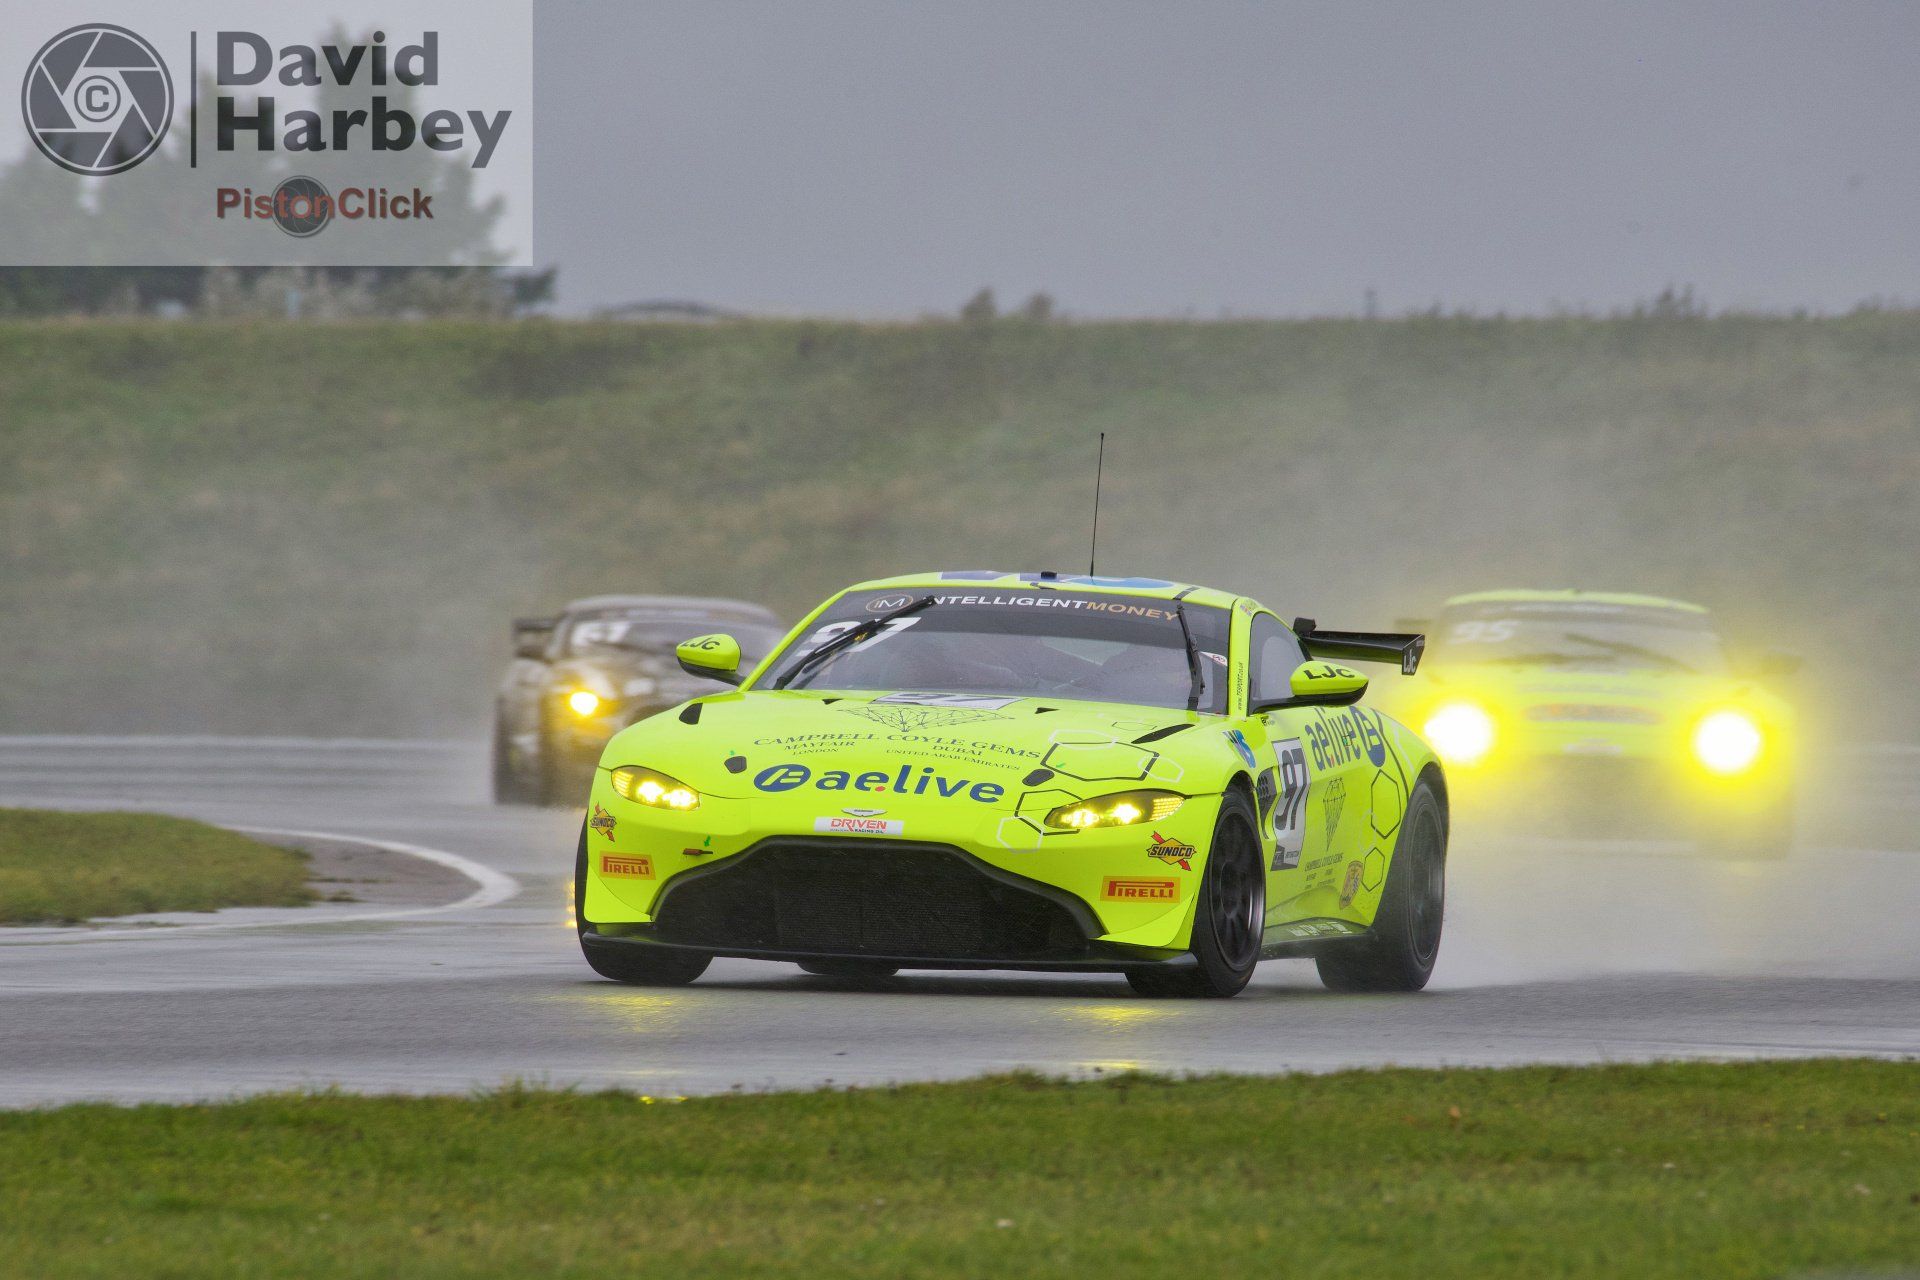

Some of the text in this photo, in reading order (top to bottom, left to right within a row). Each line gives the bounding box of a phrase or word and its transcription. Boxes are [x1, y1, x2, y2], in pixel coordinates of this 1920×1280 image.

[754, 733, 1041, 759] CAMPBELL COYLE GEMS
[784, 741, 856, 751] MAYFAIR
[793, 748, 840, 756] LONDON
[931, 744, 984, 756] DUBAI
[932, 752, 961, 760] ARAB
[1274, 747, 1307, 832] 97
[591, 816, 616, 830] SUNOCO
[830, 818, 888, 831] DRIVEN
[1149, 846, 1193, 857] SUNOCO
[602, 856, 651, 876] PIRELLI
[1107, 880, 1175, 899] PIRELLI
